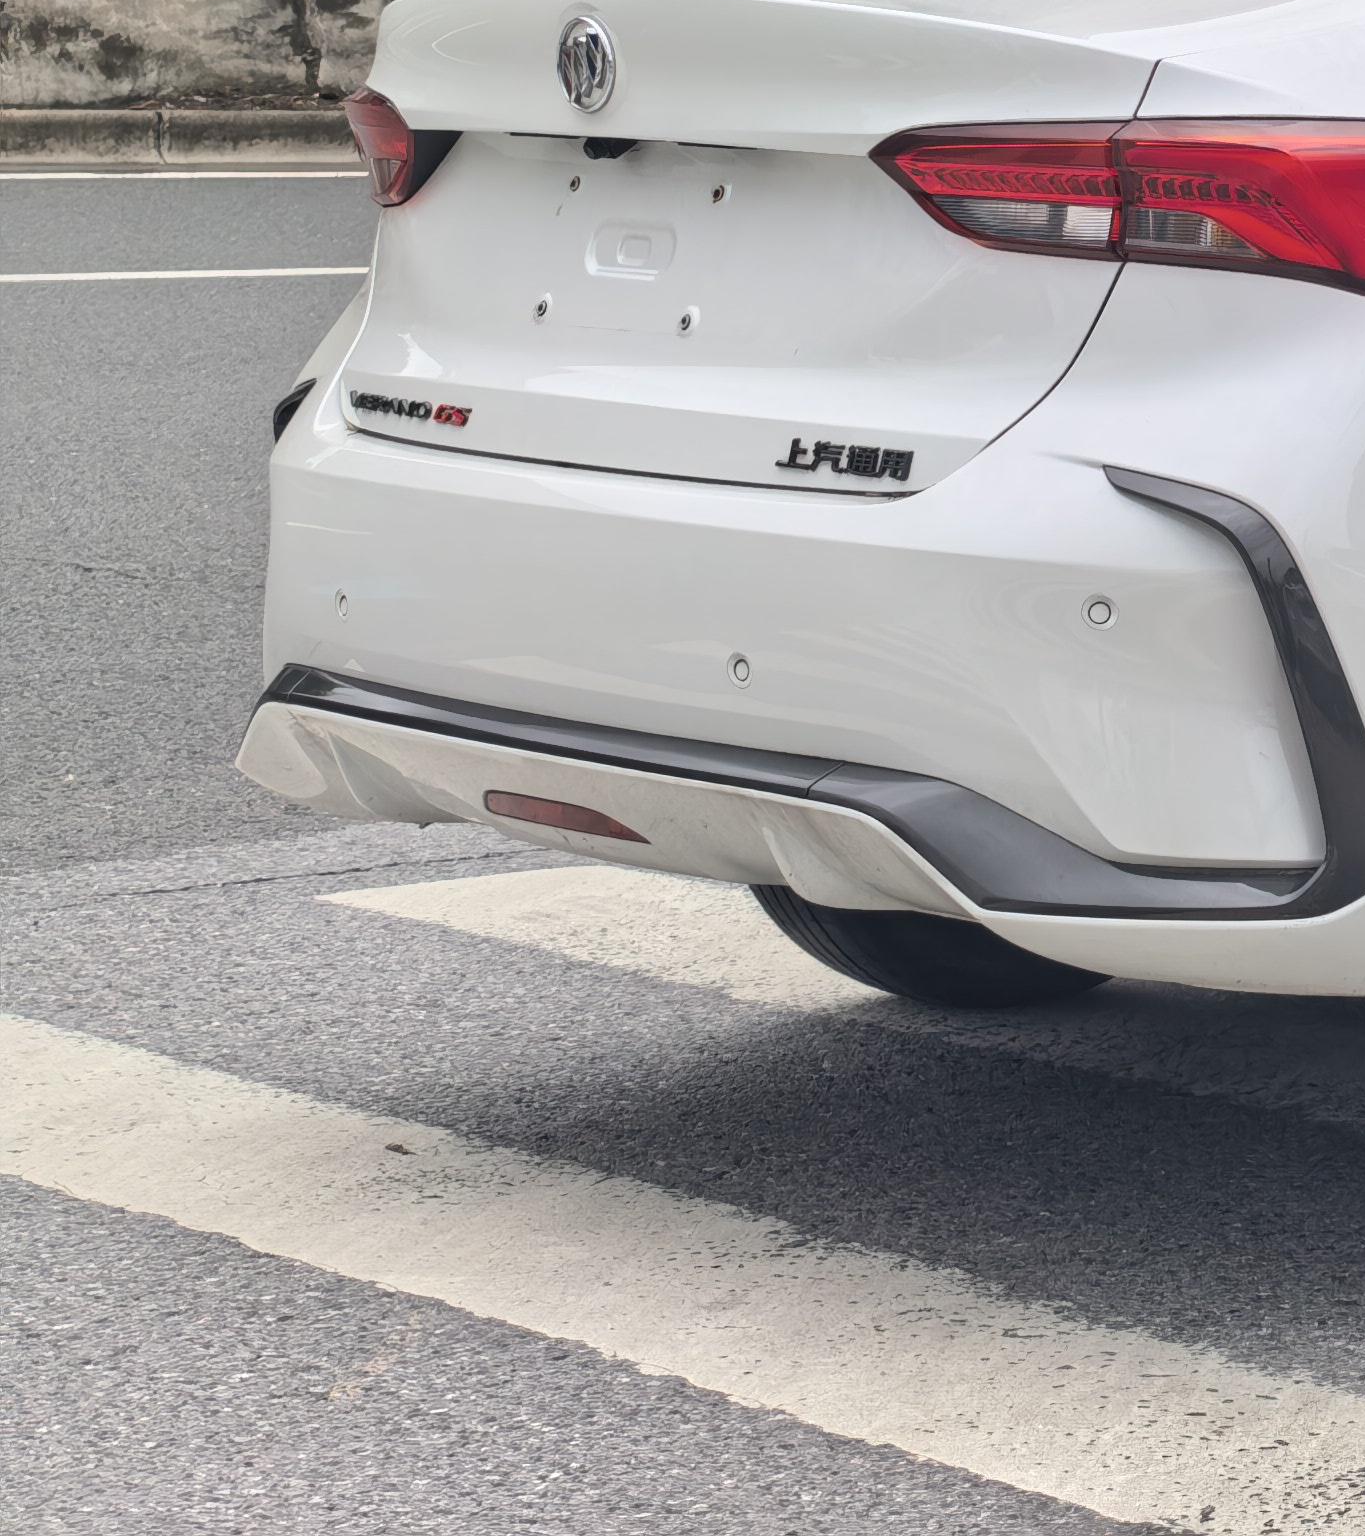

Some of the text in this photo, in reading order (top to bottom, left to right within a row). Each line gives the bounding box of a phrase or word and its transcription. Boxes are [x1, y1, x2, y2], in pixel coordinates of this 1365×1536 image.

[433, 403, 473, 427] GS
[774, 437, 915, 482] 上汽通用
